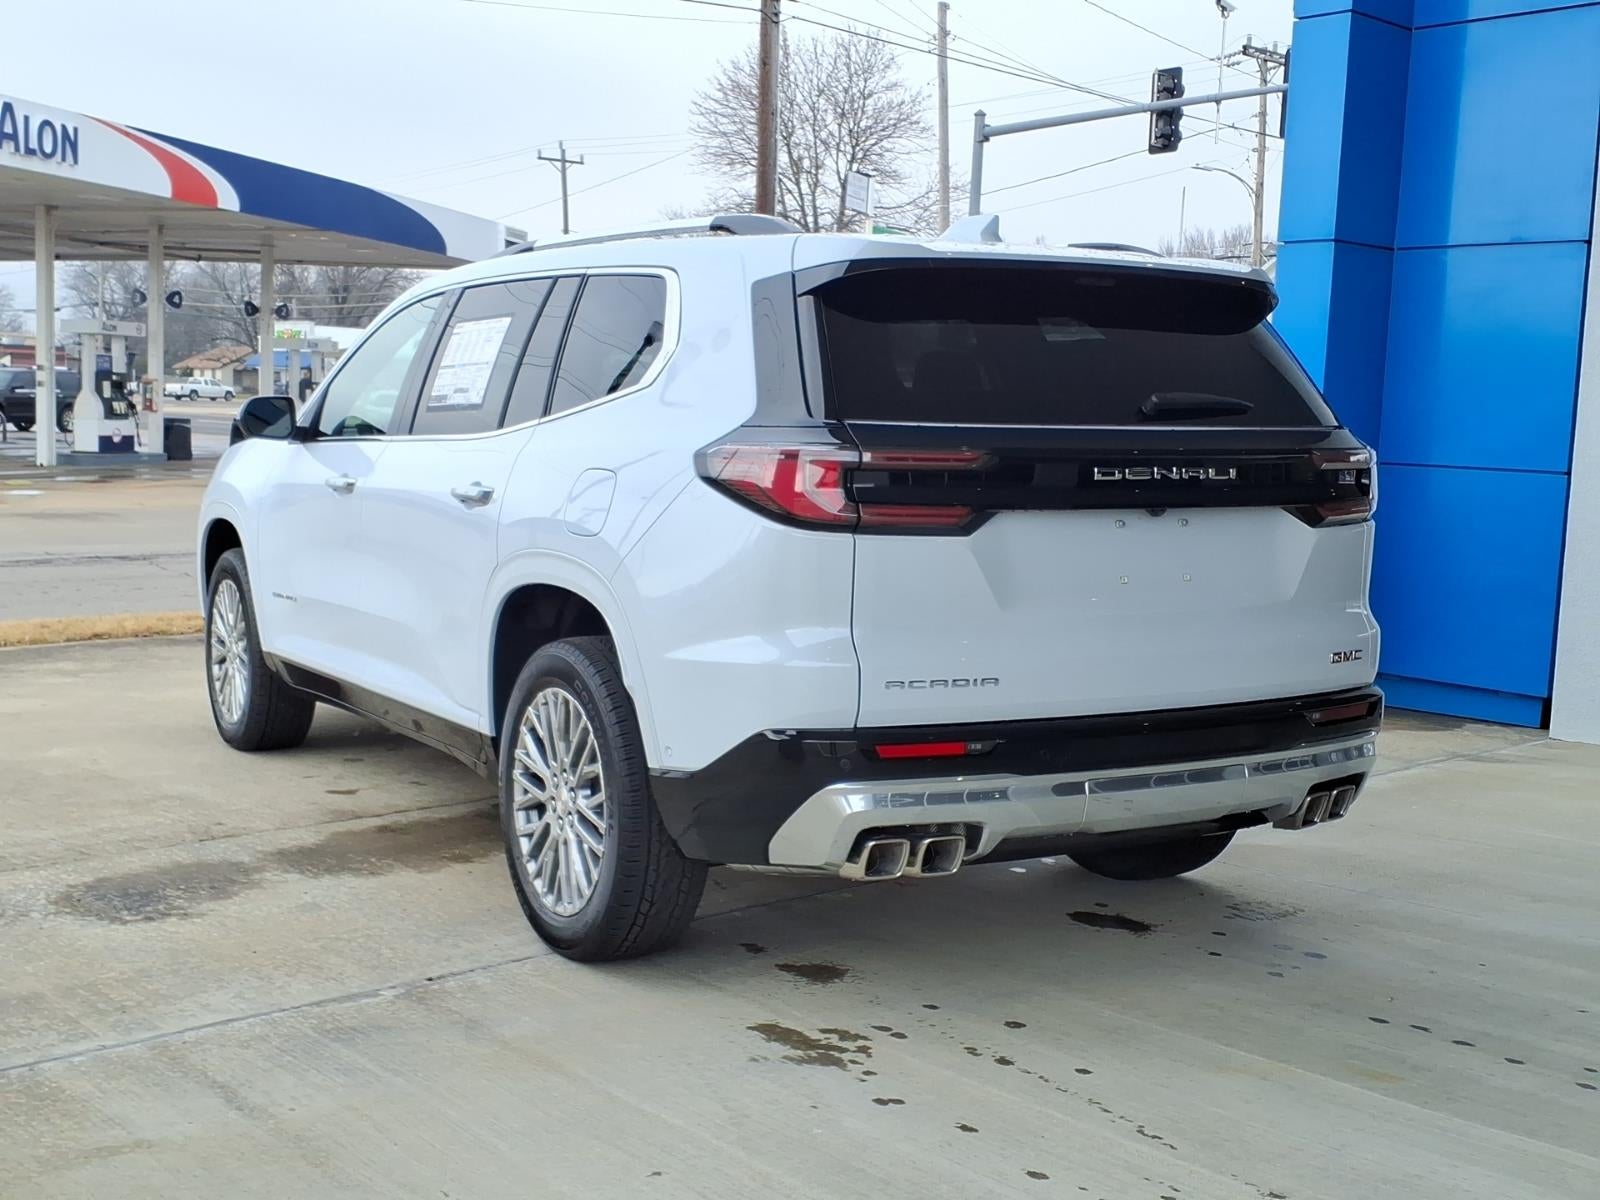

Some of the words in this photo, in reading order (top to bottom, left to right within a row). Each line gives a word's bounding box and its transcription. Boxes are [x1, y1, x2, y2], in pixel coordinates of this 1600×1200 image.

[0, 101, 79, 165] ALON
[1093, 466, 1237, 481] DENALI
[1330, 649, 1363, 664] GMC
[884, 677, 1000, 690] ACADIA
